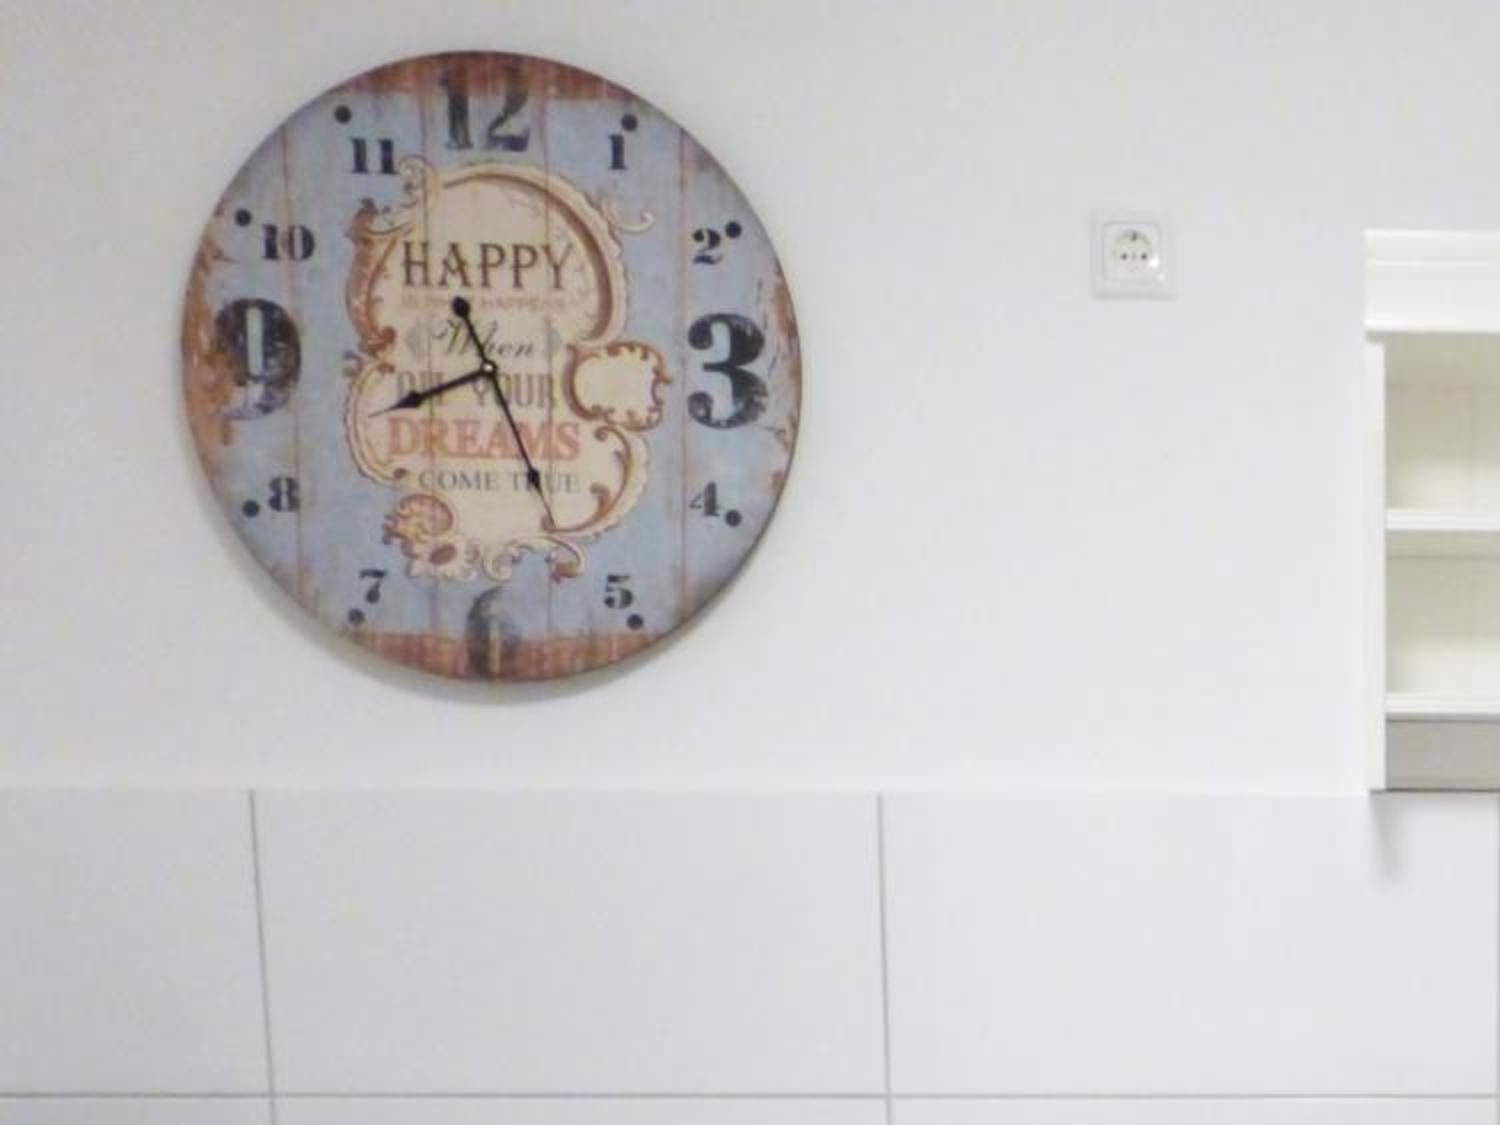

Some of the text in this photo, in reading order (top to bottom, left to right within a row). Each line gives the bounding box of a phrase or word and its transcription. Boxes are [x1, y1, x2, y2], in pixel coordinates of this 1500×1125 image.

[438, 66, 531, 151] 12
[350, 137, 399, 174] 11
[608, 134, 627, 170] 1
[261, 223, 316, 261] 10
[692, 228, 722, 265] 2
[402, 241, 573, 289] HAPPY
[687, 312, 767, 429] 3
[388, 416, 580, 460] DREAMS
[268, 475, 301, 512] 8
[418, 470, 500, 492] COME
[689, 481, 721, 518] 4
[359, 568, 388, 604] 7
[604, 573, 634, 609] 5
[465, 585, 523, 681] 6
